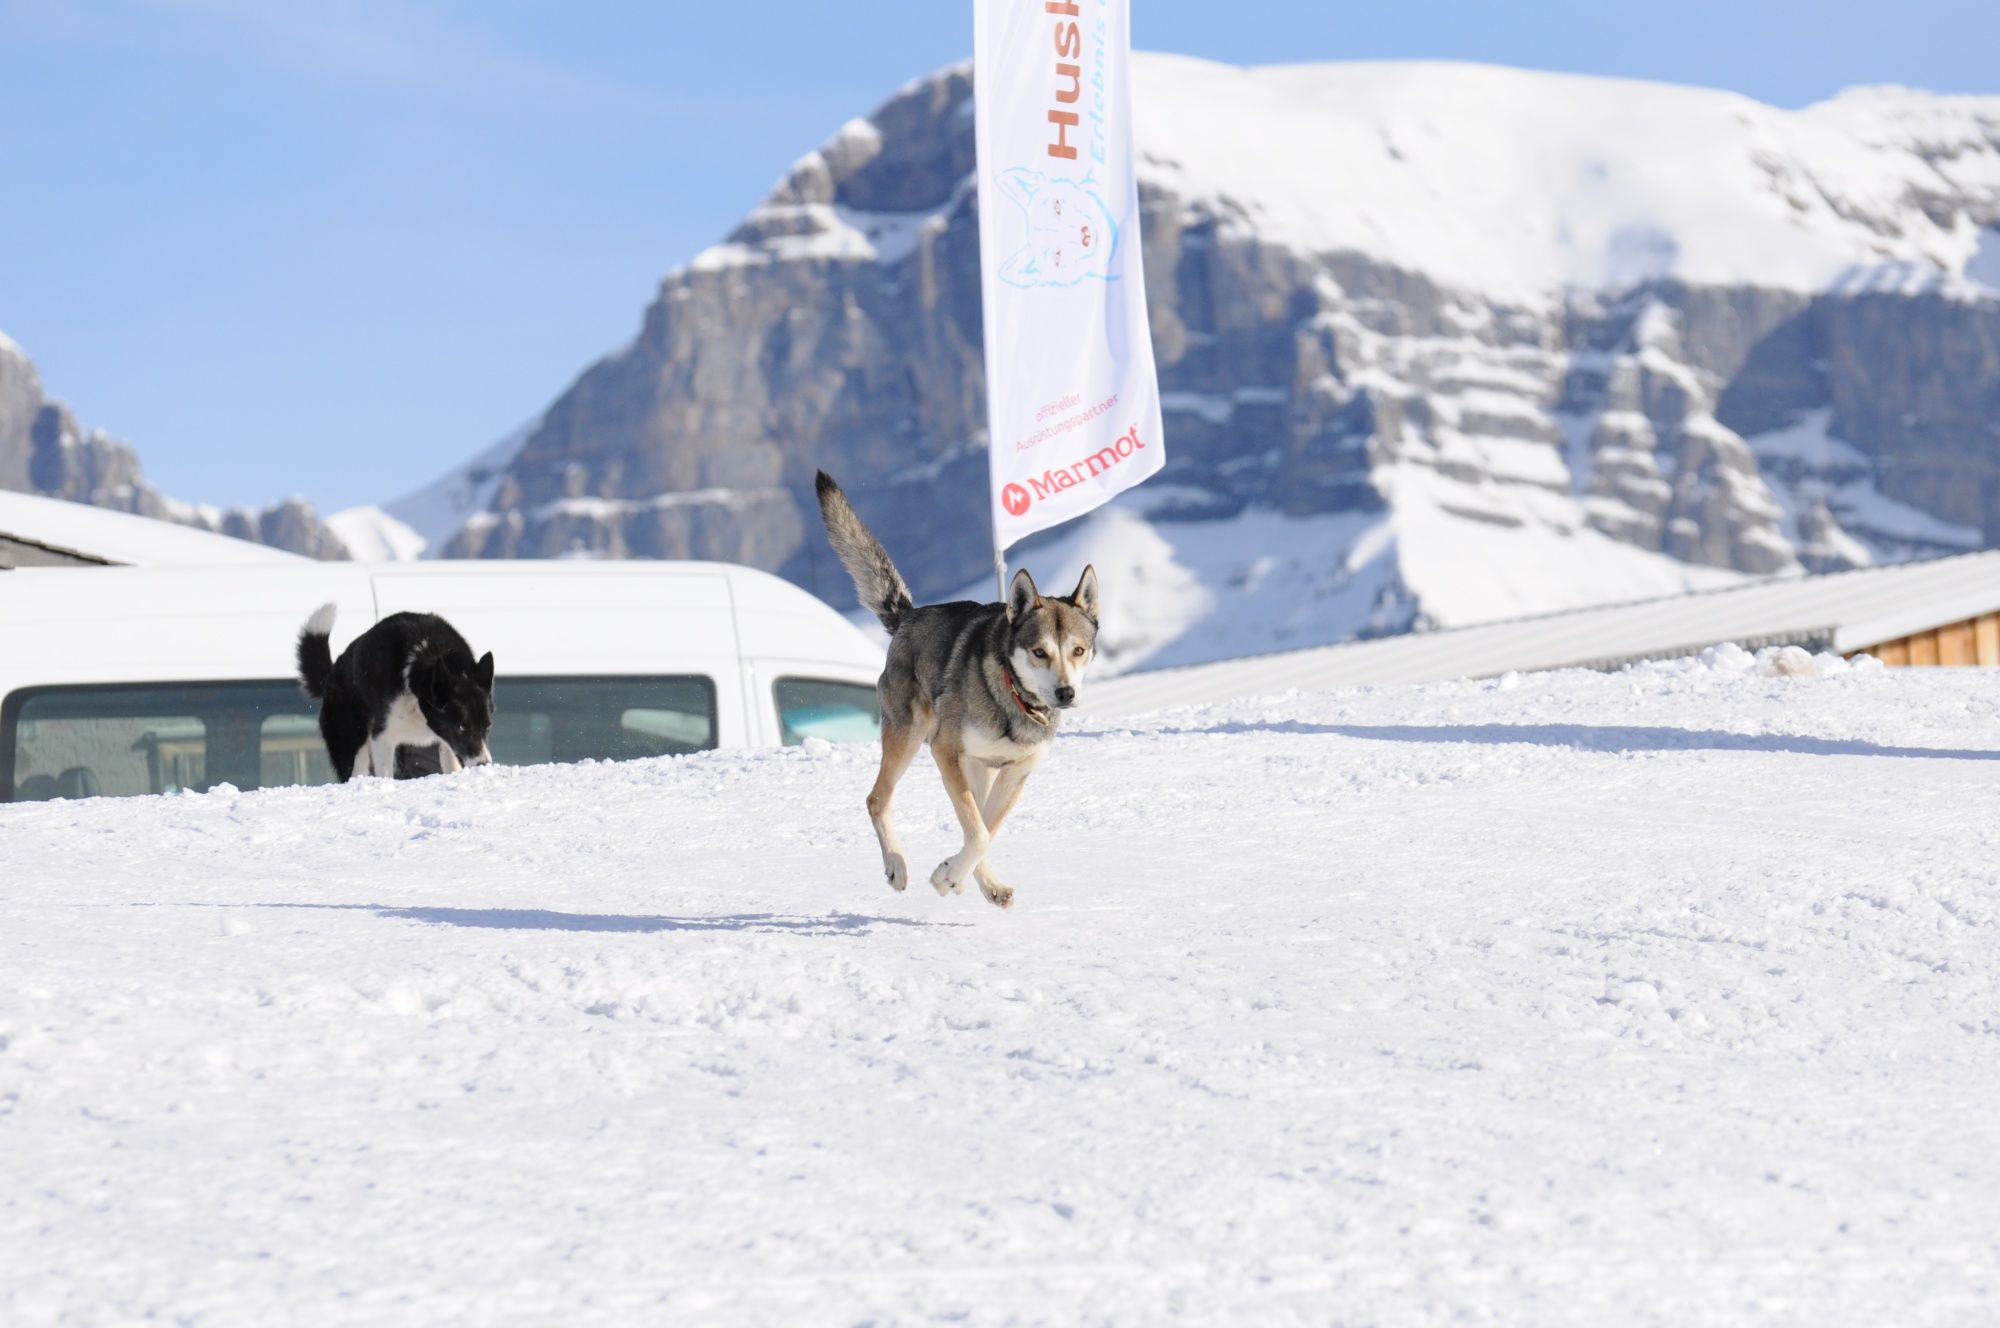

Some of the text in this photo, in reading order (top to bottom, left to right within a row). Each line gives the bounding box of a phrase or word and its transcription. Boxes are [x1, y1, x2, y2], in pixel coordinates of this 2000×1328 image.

[1090, 19, 1105, 165] Erlebnis
[1036, 393, 1081, 422] offizieller
[1027, 425, 1145, 500] Marmot
